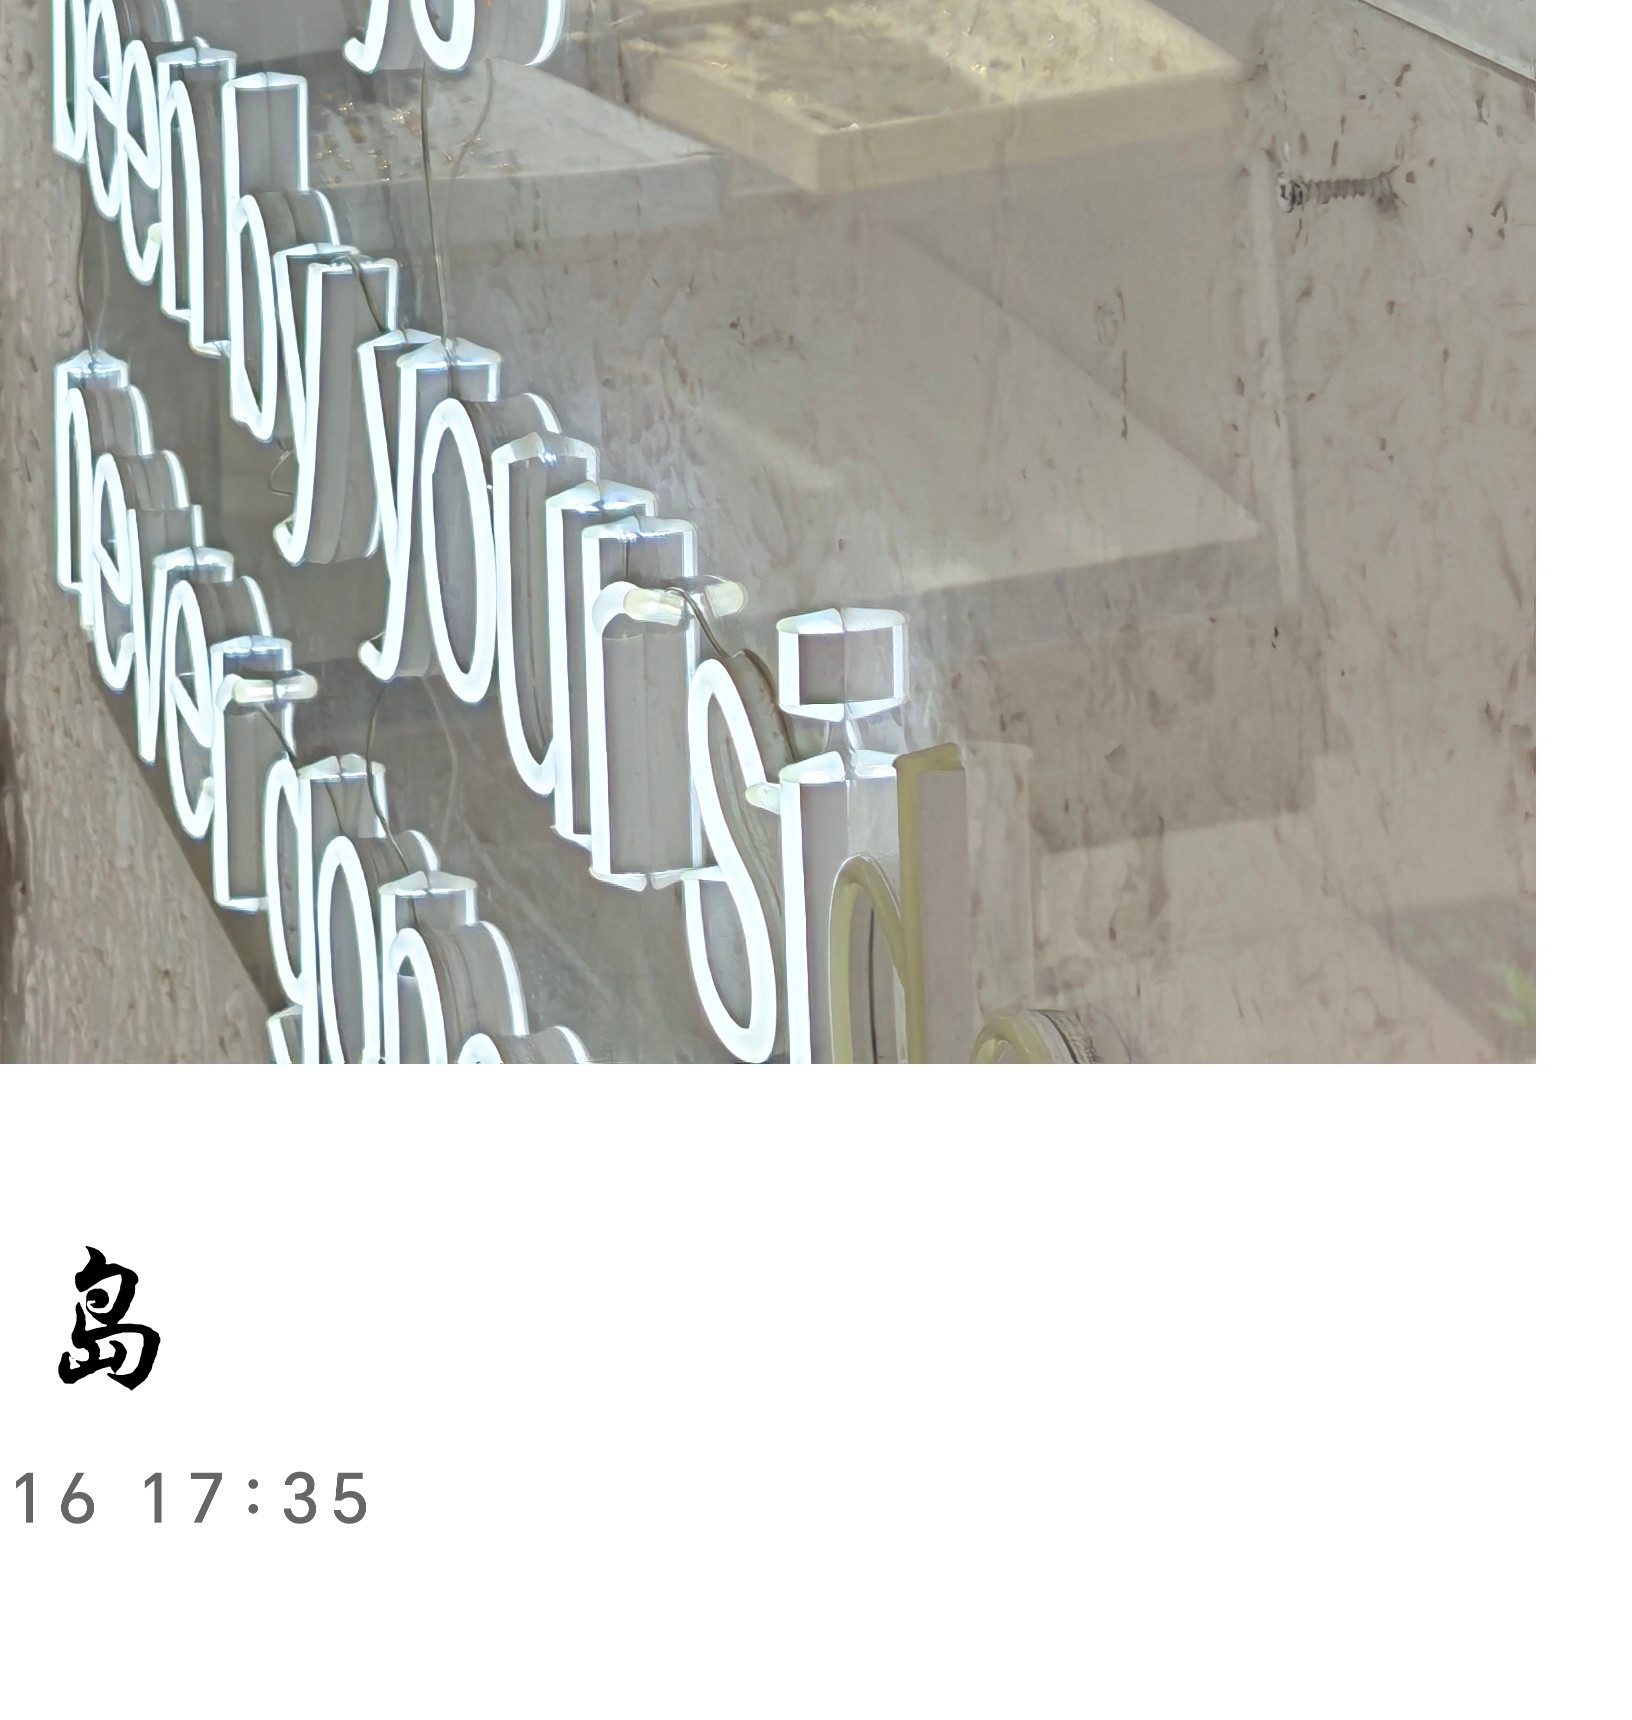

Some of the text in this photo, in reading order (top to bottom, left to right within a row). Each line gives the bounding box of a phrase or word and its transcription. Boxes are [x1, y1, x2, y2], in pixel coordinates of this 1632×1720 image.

[55, 350, 304, 913] never
[224, 72, 354, 563] by
[357, 331, 694, 889] your
